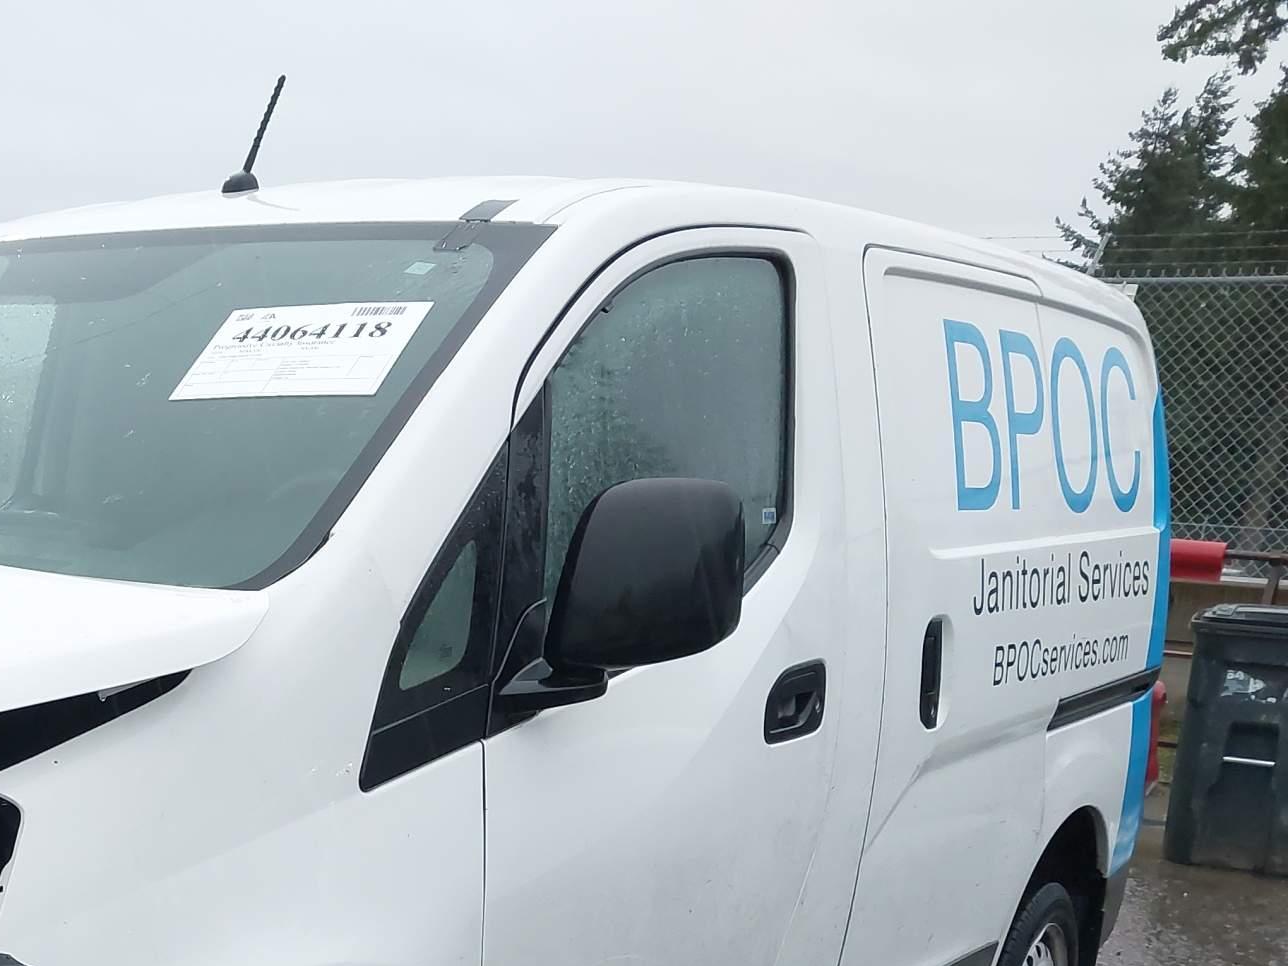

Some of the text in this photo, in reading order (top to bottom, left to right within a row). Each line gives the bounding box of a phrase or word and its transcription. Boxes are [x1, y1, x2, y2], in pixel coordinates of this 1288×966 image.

[231, 321, 393, 343] 44064118
[943, 318, 1141, 514] BPOC
[973, 550, 1150, 616] Janitorial Services
[992, 632, 1130, 687] BPOCservices.com
